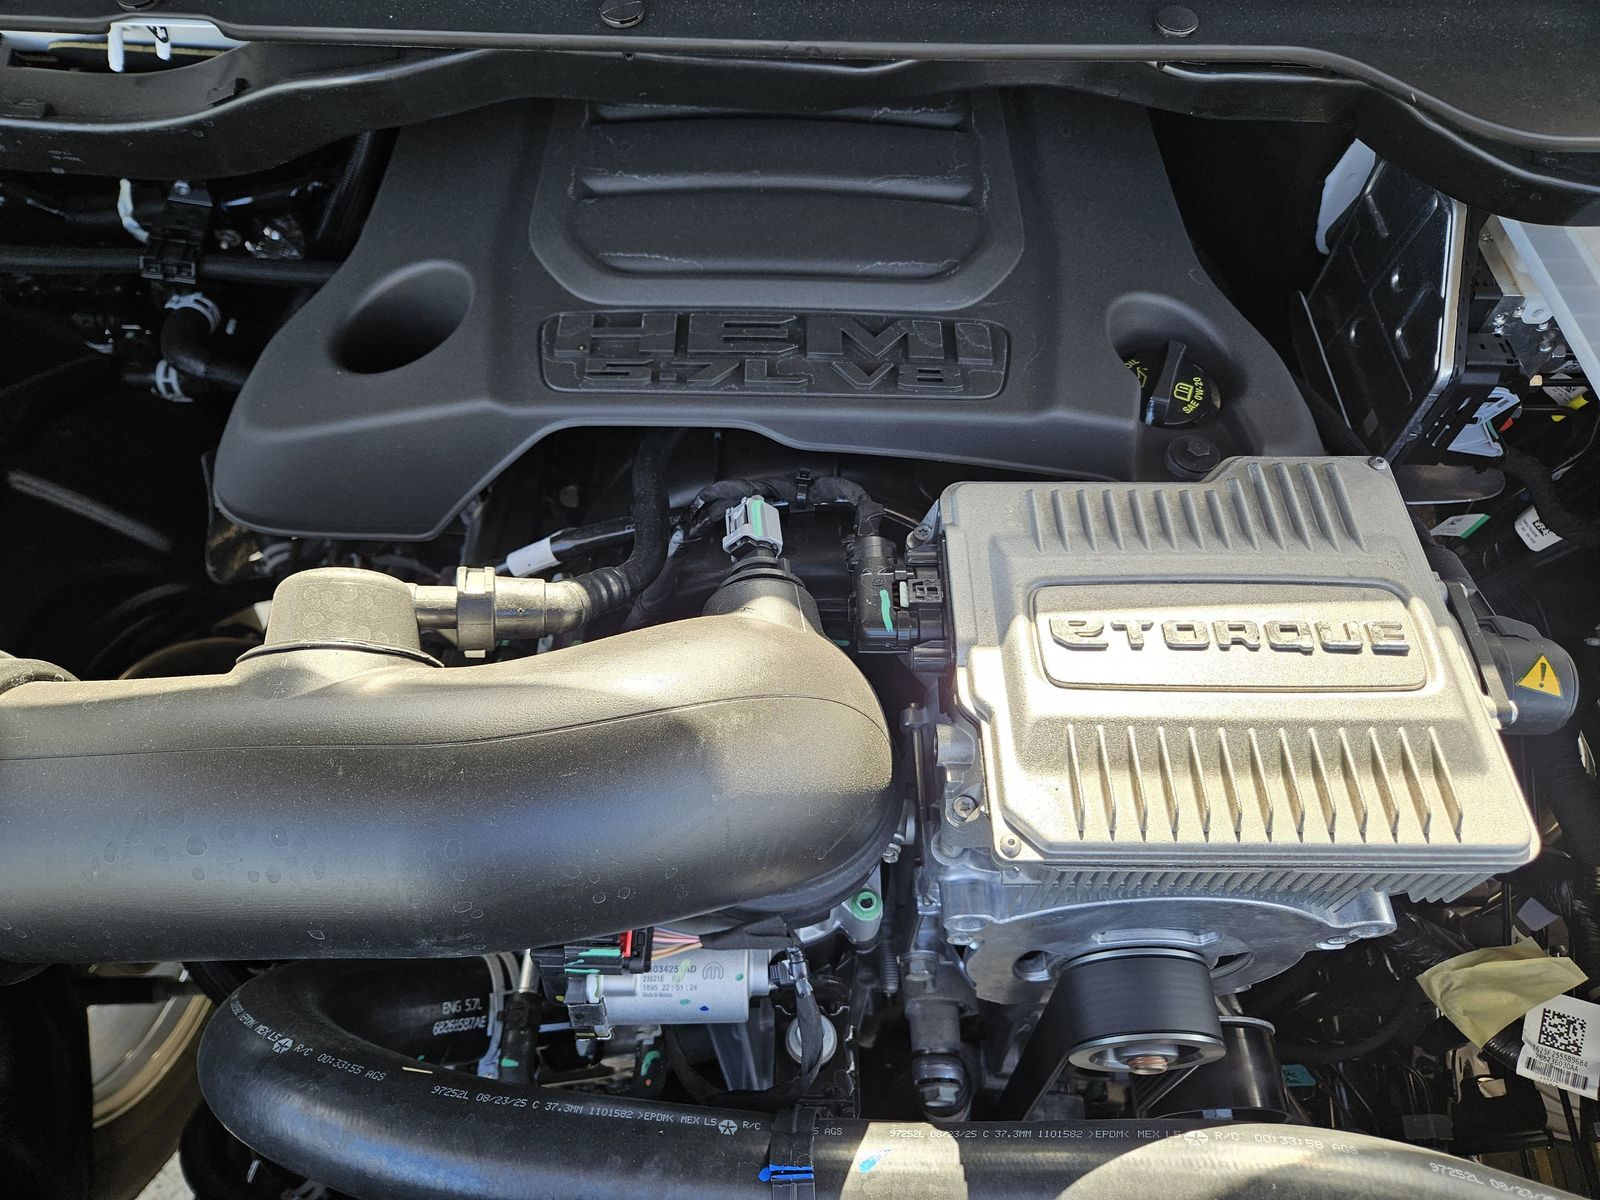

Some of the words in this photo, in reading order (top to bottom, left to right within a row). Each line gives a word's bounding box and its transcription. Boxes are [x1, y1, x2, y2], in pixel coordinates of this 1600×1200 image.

[553, 311, 994, 366] HEMI
[831, 360, 966, 392] V8
[1182, 400, 1200, 414] SAE
[441, 1000, 462, 1015] ENG
[365, 1069, 387, 1081] AGS
[431, 1085, 469, 1100] 97252L
[475, 1092, 529, 1108] 08/23/25
[532, 1100, 541, 1110] C
[544, 1102, 584, 1115] 37.3MM
[589, 1106, 634, 1119] 1101582
[680, 1115, 700, 1124] MEX
[742, 1120, 762, 1130] R/C
[824, 1127, 843, 1136] AGS
[982, 1130, 989, 1138] C
[994, 1129, 1032, 1138] 37.3MM
[1038, 1130, 1084, 1138] 1101582
[1137, 1130, 1160, 1139] MEX
[1214, 1131, 1240, 1141] R/C
[1331, 1143, 1360, 1155] AGS
[1429, 1162, 1485, 1185] 97252L
